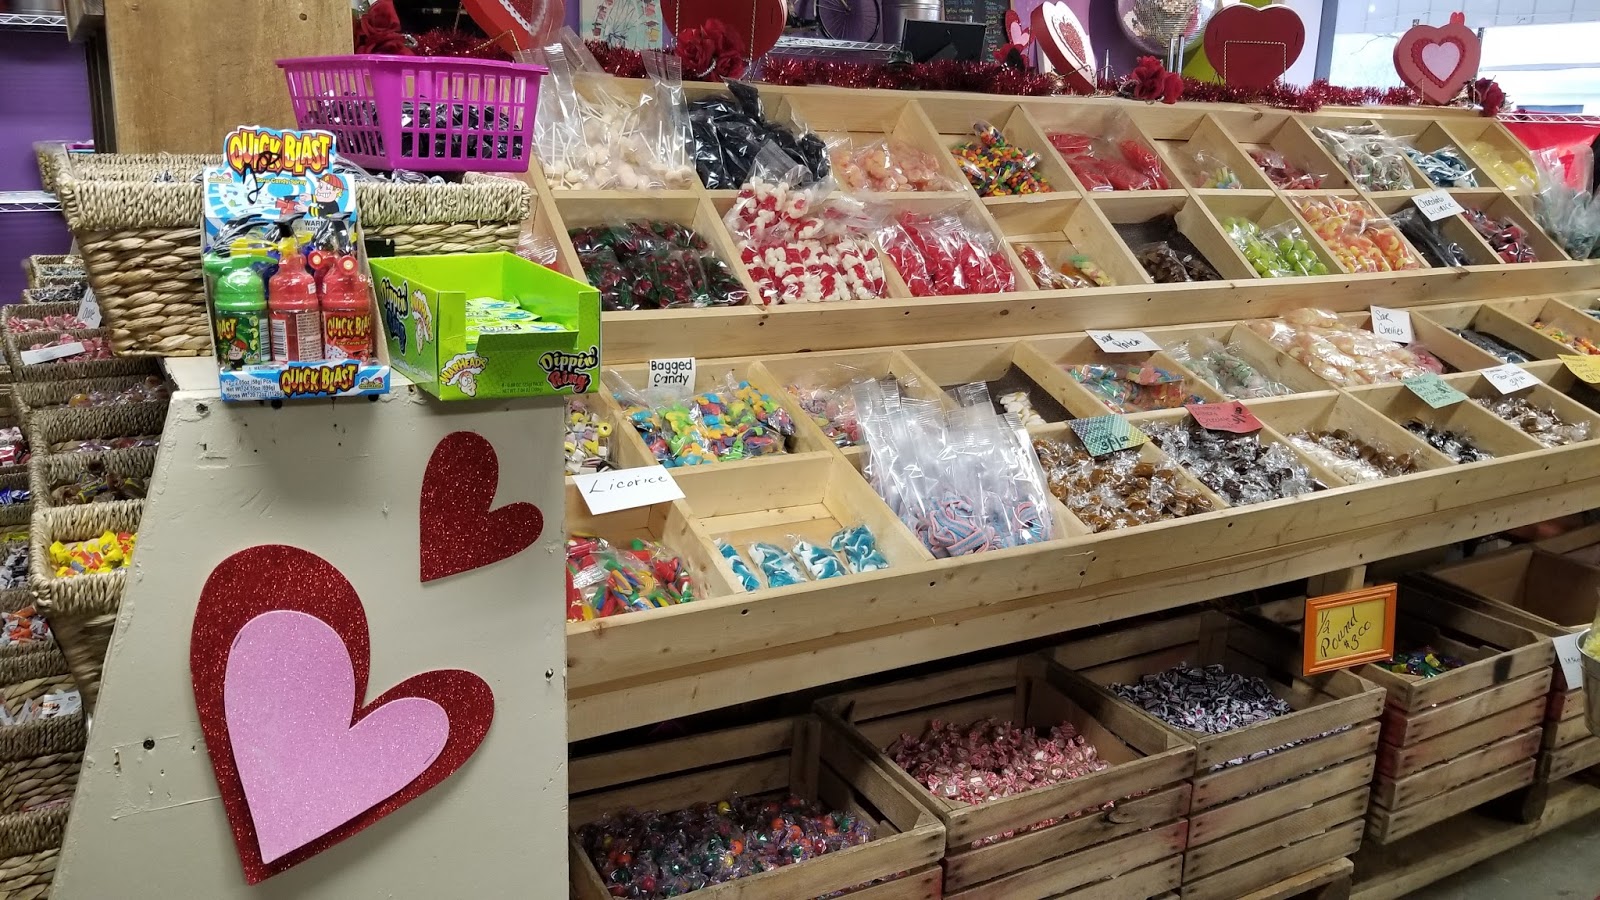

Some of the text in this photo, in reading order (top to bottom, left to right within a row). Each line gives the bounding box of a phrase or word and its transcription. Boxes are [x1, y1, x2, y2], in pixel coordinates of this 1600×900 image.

[229, 129, 332, 175] QUICK BLAST
[327, 316, 354, 337] QUICK
[440, 356, 486, 383] WARHEADS
[651, 359, 692, 374] Bagged
[280, 367, 319, 396] QUICK
[320, 364, 358, 393] BLAST
[548, 371, 591, 393] Ring
[654, 373, 689, 386] Candy
[589, 475, 668, 494] Licorice
[1320, 606, 1358, 658] Pound
